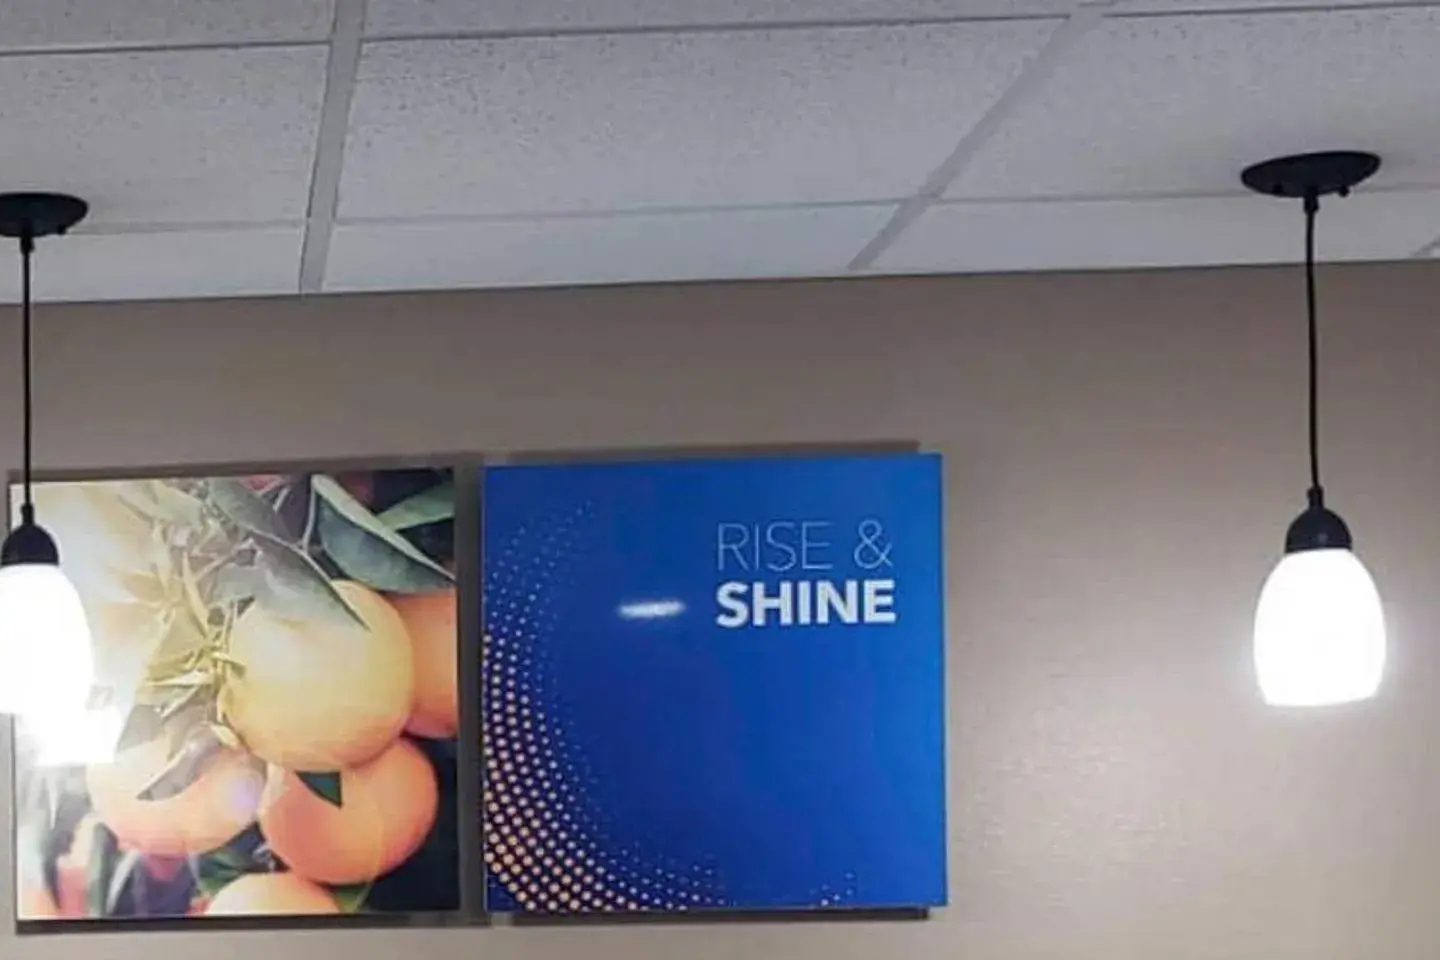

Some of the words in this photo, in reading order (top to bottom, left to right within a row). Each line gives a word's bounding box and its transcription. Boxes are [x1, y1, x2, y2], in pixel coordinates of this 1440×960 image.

[717, 521, 834, 571] RISE
[854, 518, 894, 570] &
[716, 579, 897, 628] SHINE
